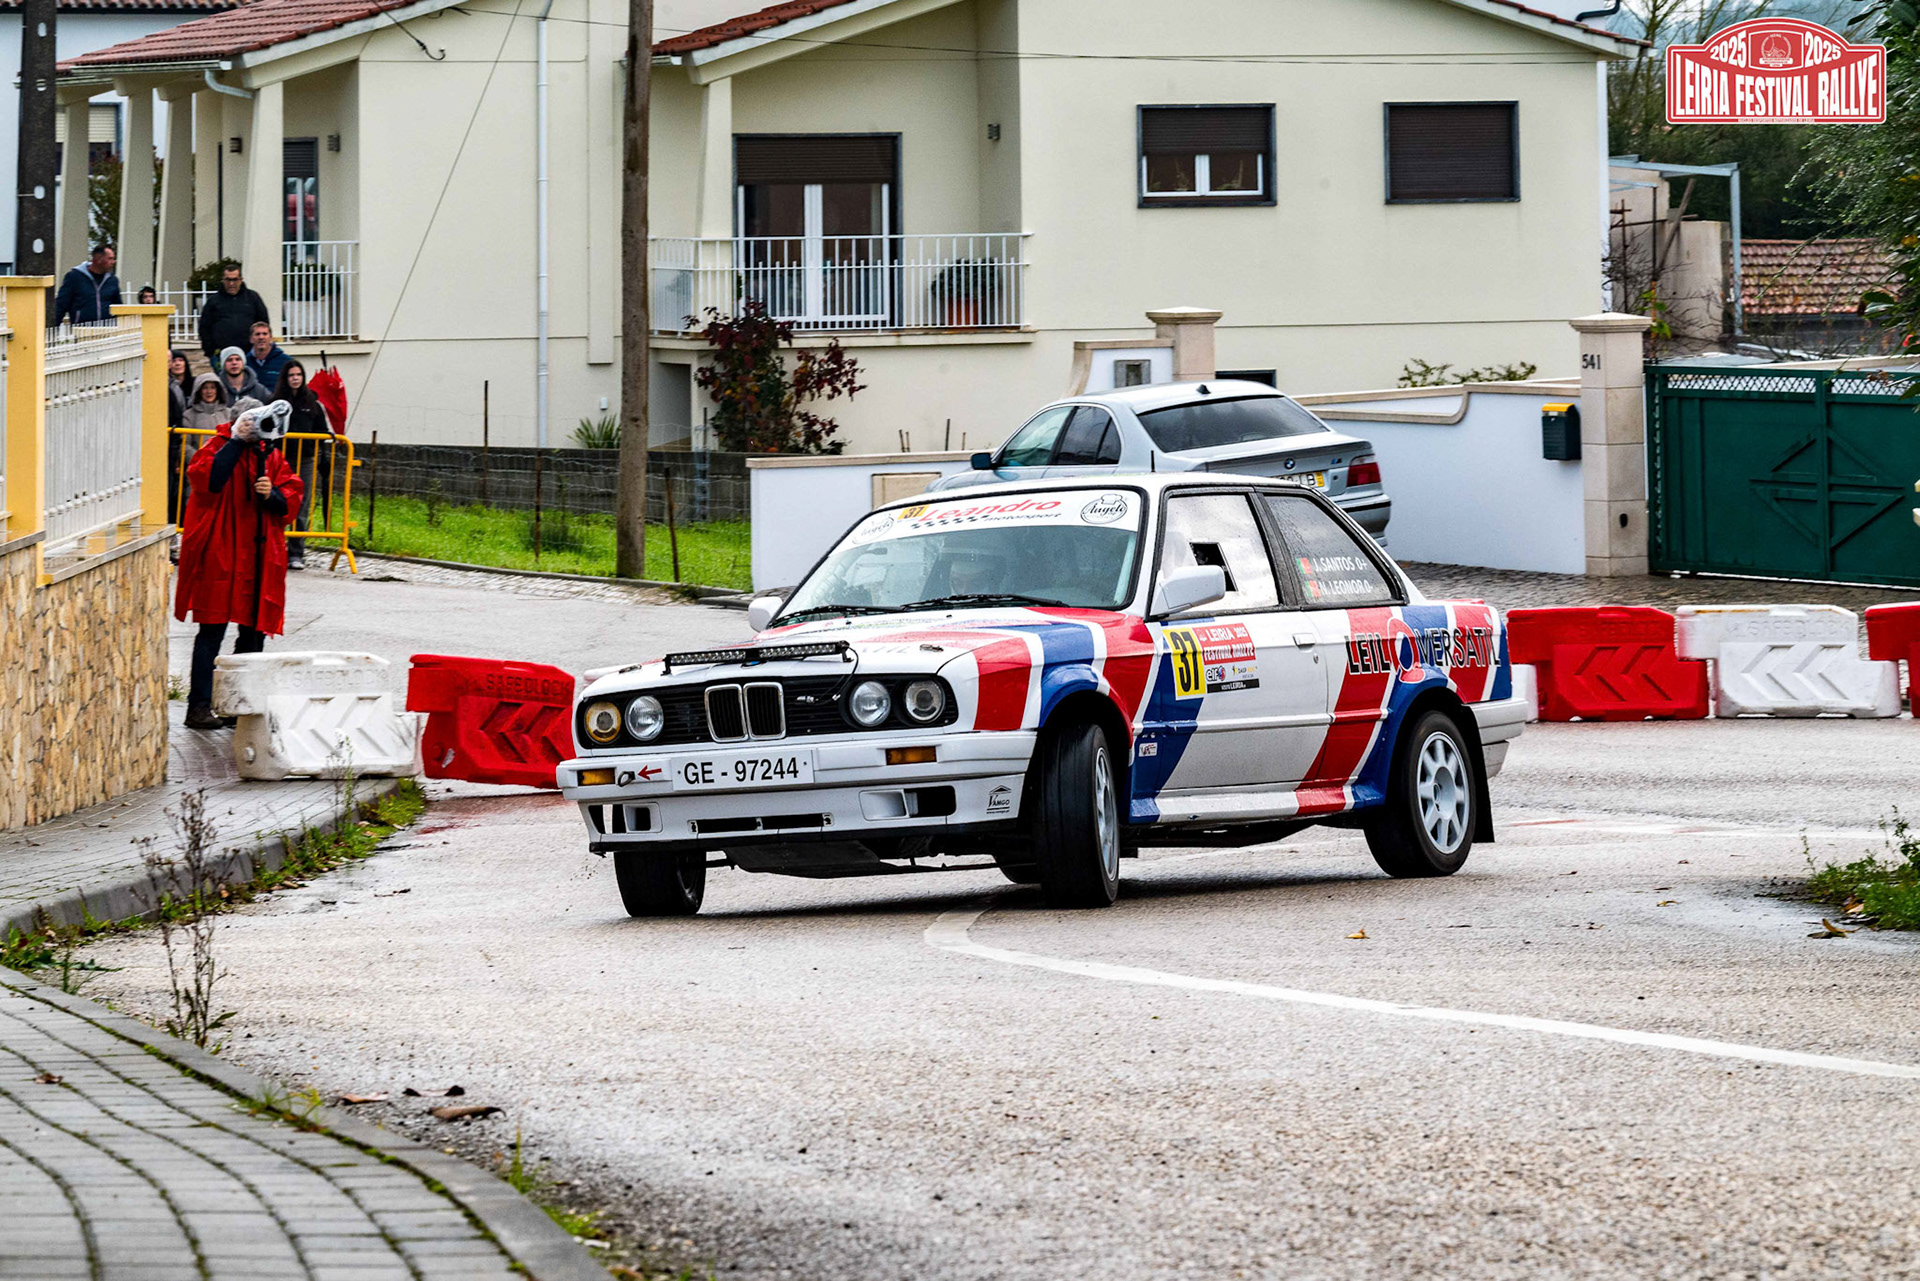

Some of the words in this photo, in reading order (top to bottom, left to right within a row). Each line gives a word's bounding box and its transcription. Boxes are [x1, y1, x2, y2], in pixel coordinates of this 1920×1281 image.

[1581, 354, 1601, 370] 541
[903, 506, 925, 519] 37
[918, 499, 1061, 522] Leandro
[985, 513, 1062, 522] motorsport
[1206, 627, 1235, 642] LEIRIA
[1204, 644, 1232, 661] FESTIVAL
[1170, 631, 1199, 692] 37
[1206, 667, 1219, 682] elf
[684, 761, 715, 785] GE
[734, 757, 799, 782] 97244
